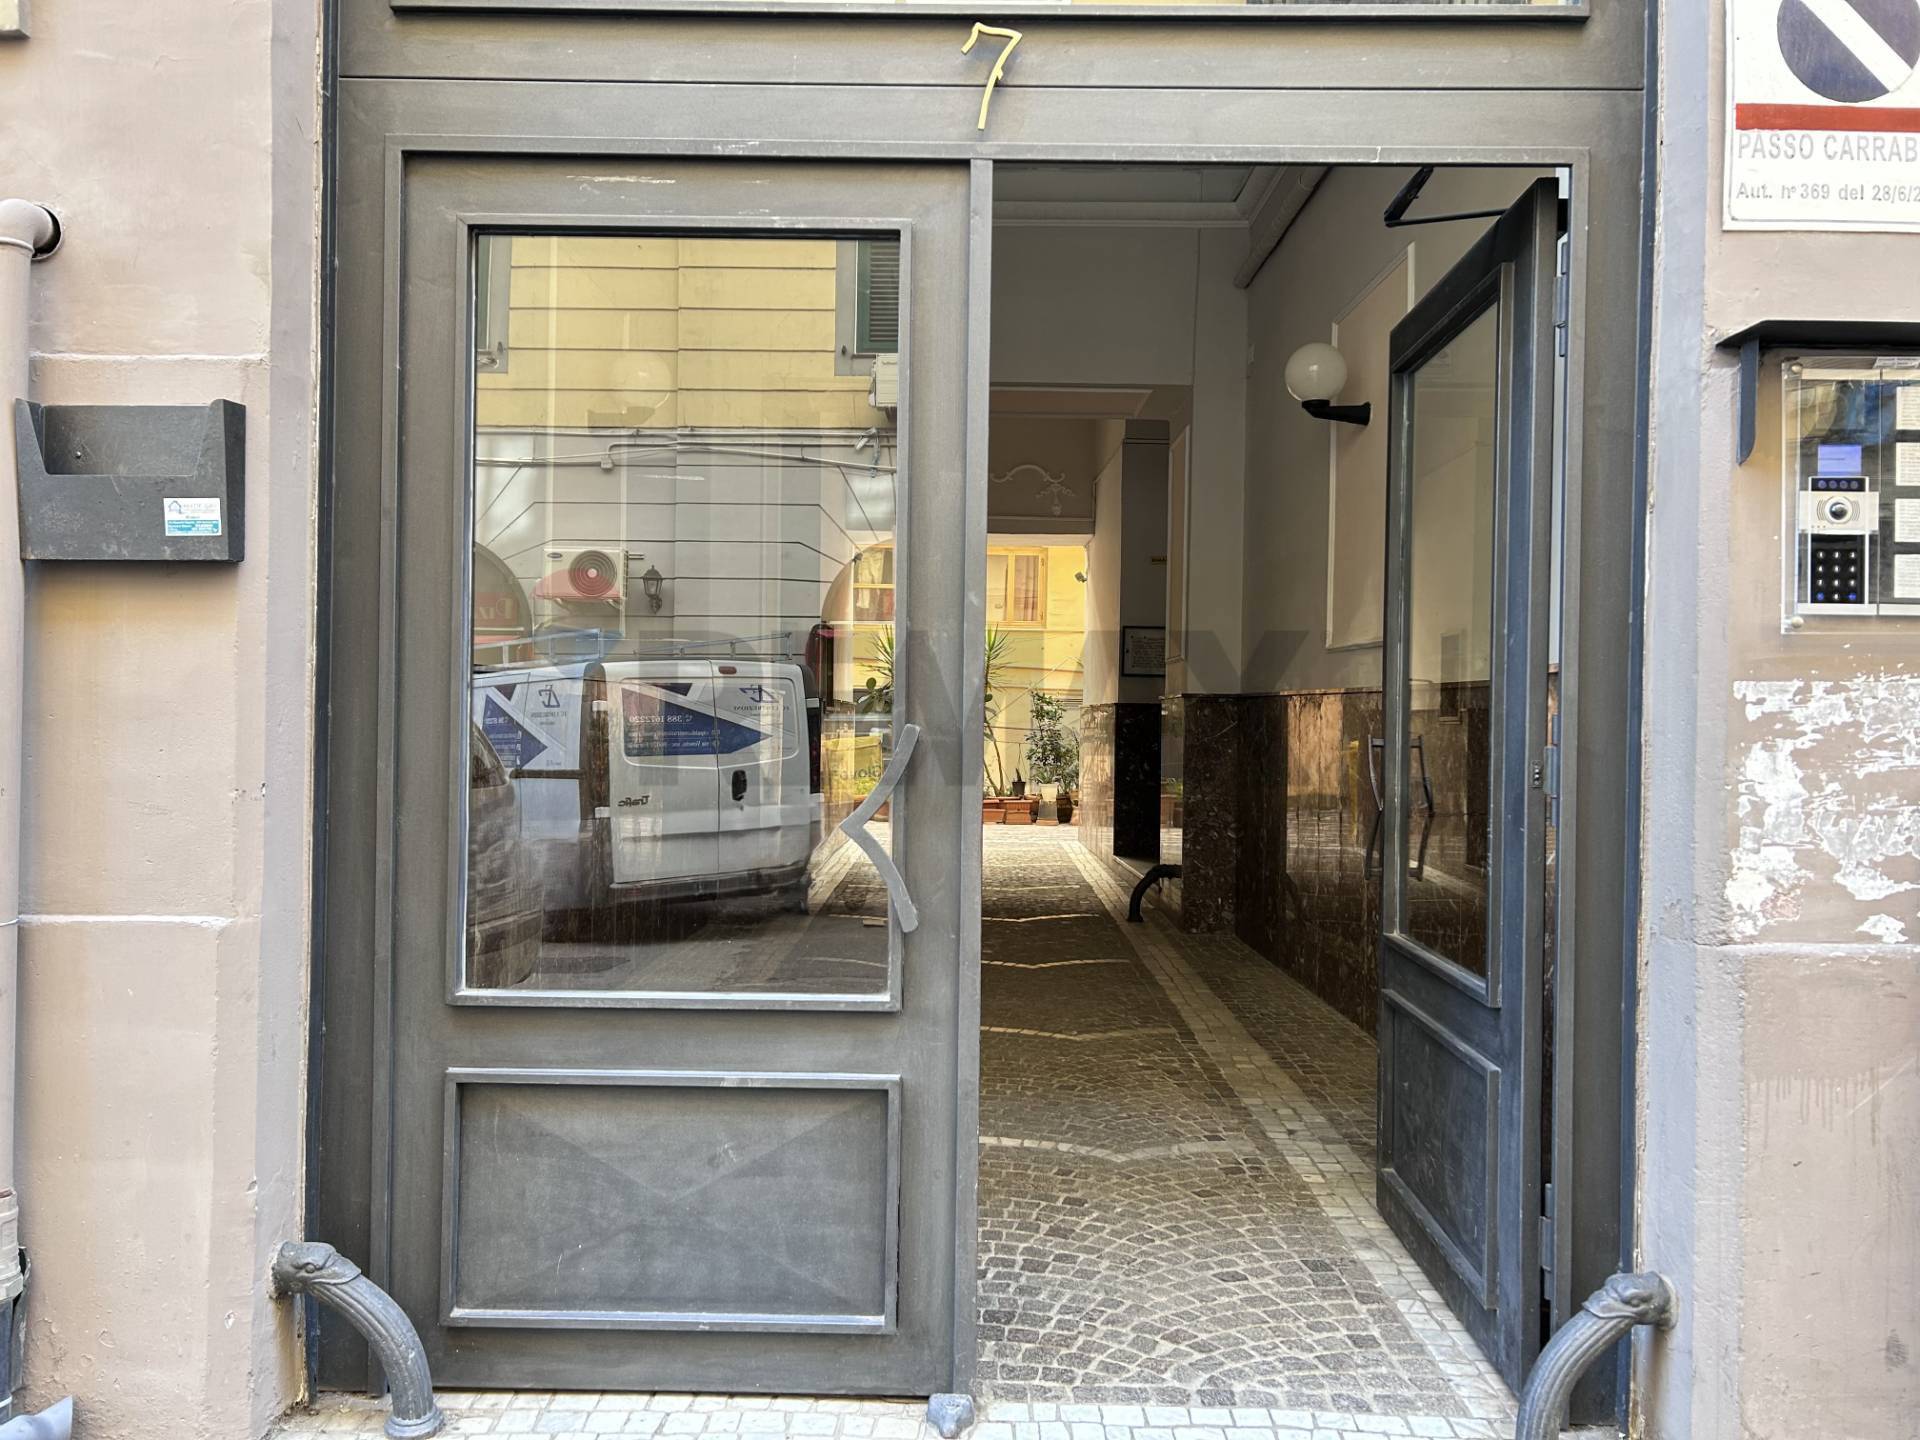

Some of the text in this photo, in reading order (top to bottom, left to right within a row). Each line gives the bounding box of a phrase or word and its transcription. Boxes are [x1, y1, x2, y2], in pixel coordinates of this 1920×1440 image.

[961, 22, 1022, 130] 7
[1737, 133, 1814, 160] PASSO
[1736, 182, 1773, 199] Aut.
[1838, 184, 1864, 201] del
